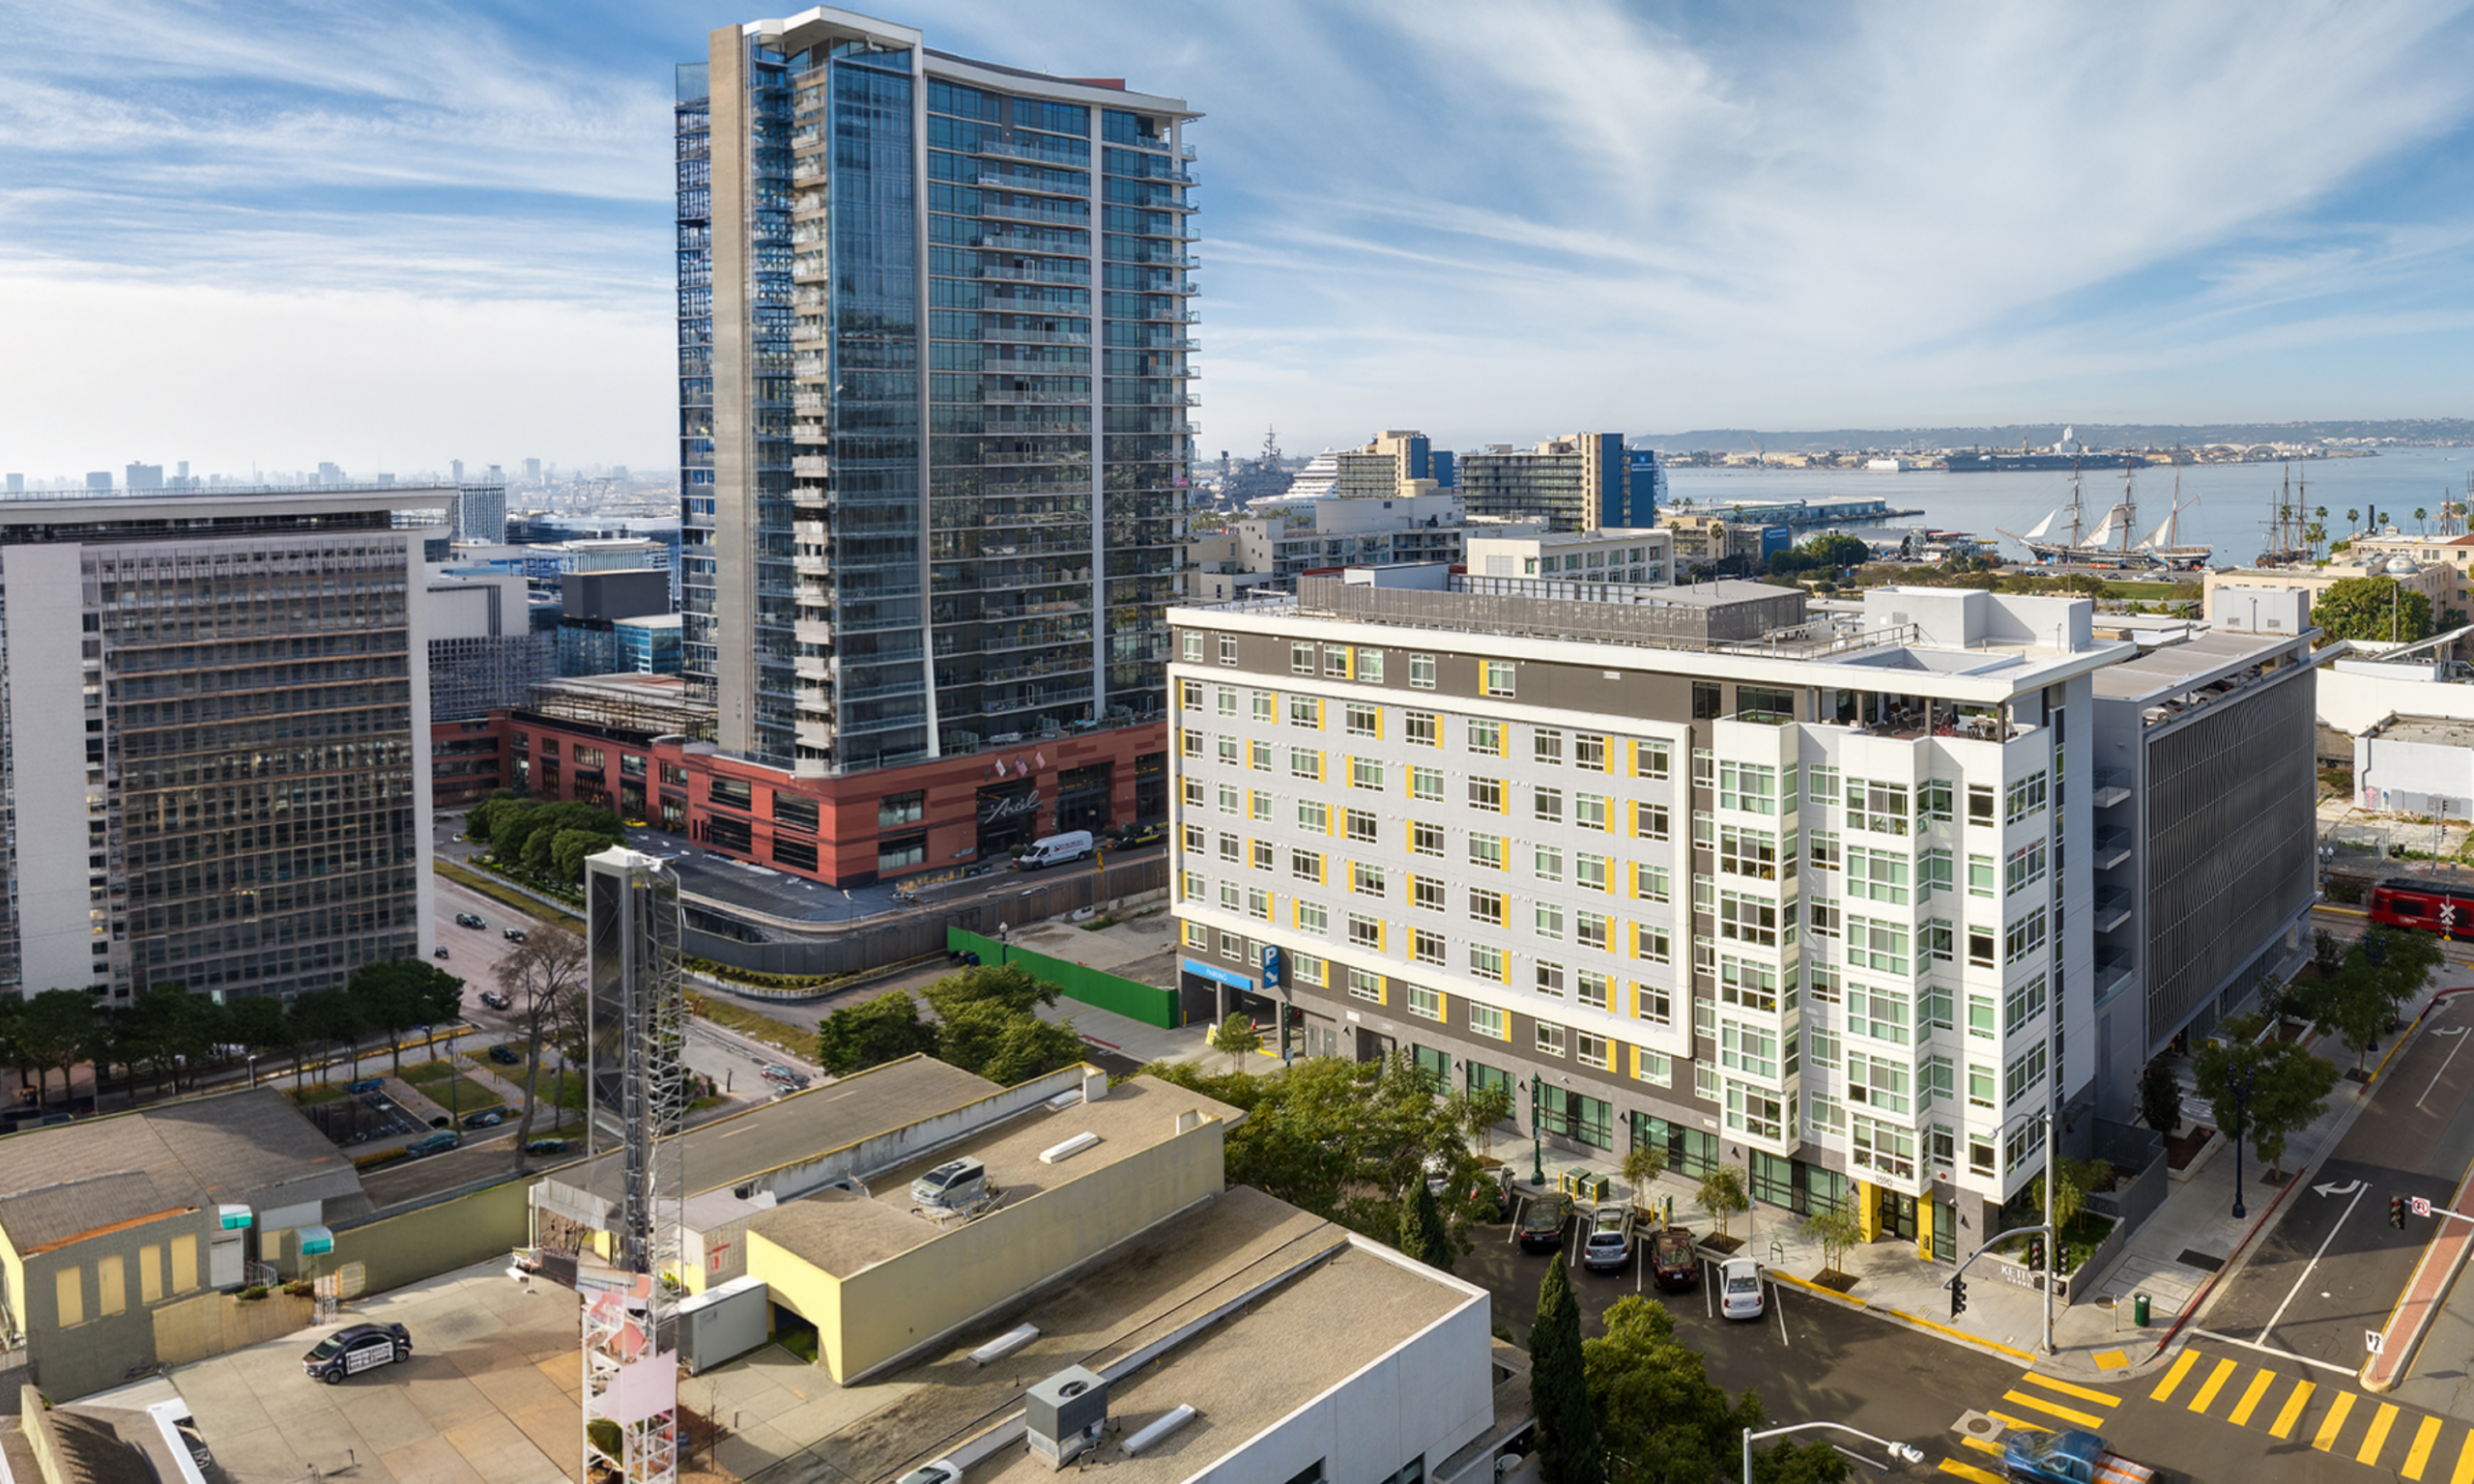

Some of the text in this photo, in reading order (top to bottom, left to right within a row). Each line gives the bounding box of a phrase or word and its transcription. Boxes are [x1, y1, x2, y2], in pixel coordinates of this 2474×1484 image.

[1265, 947, 1278, 965] P
[1206, 968, 1227, 982] PARKING
[2000, 1264, 2035, 1283] KETTN
